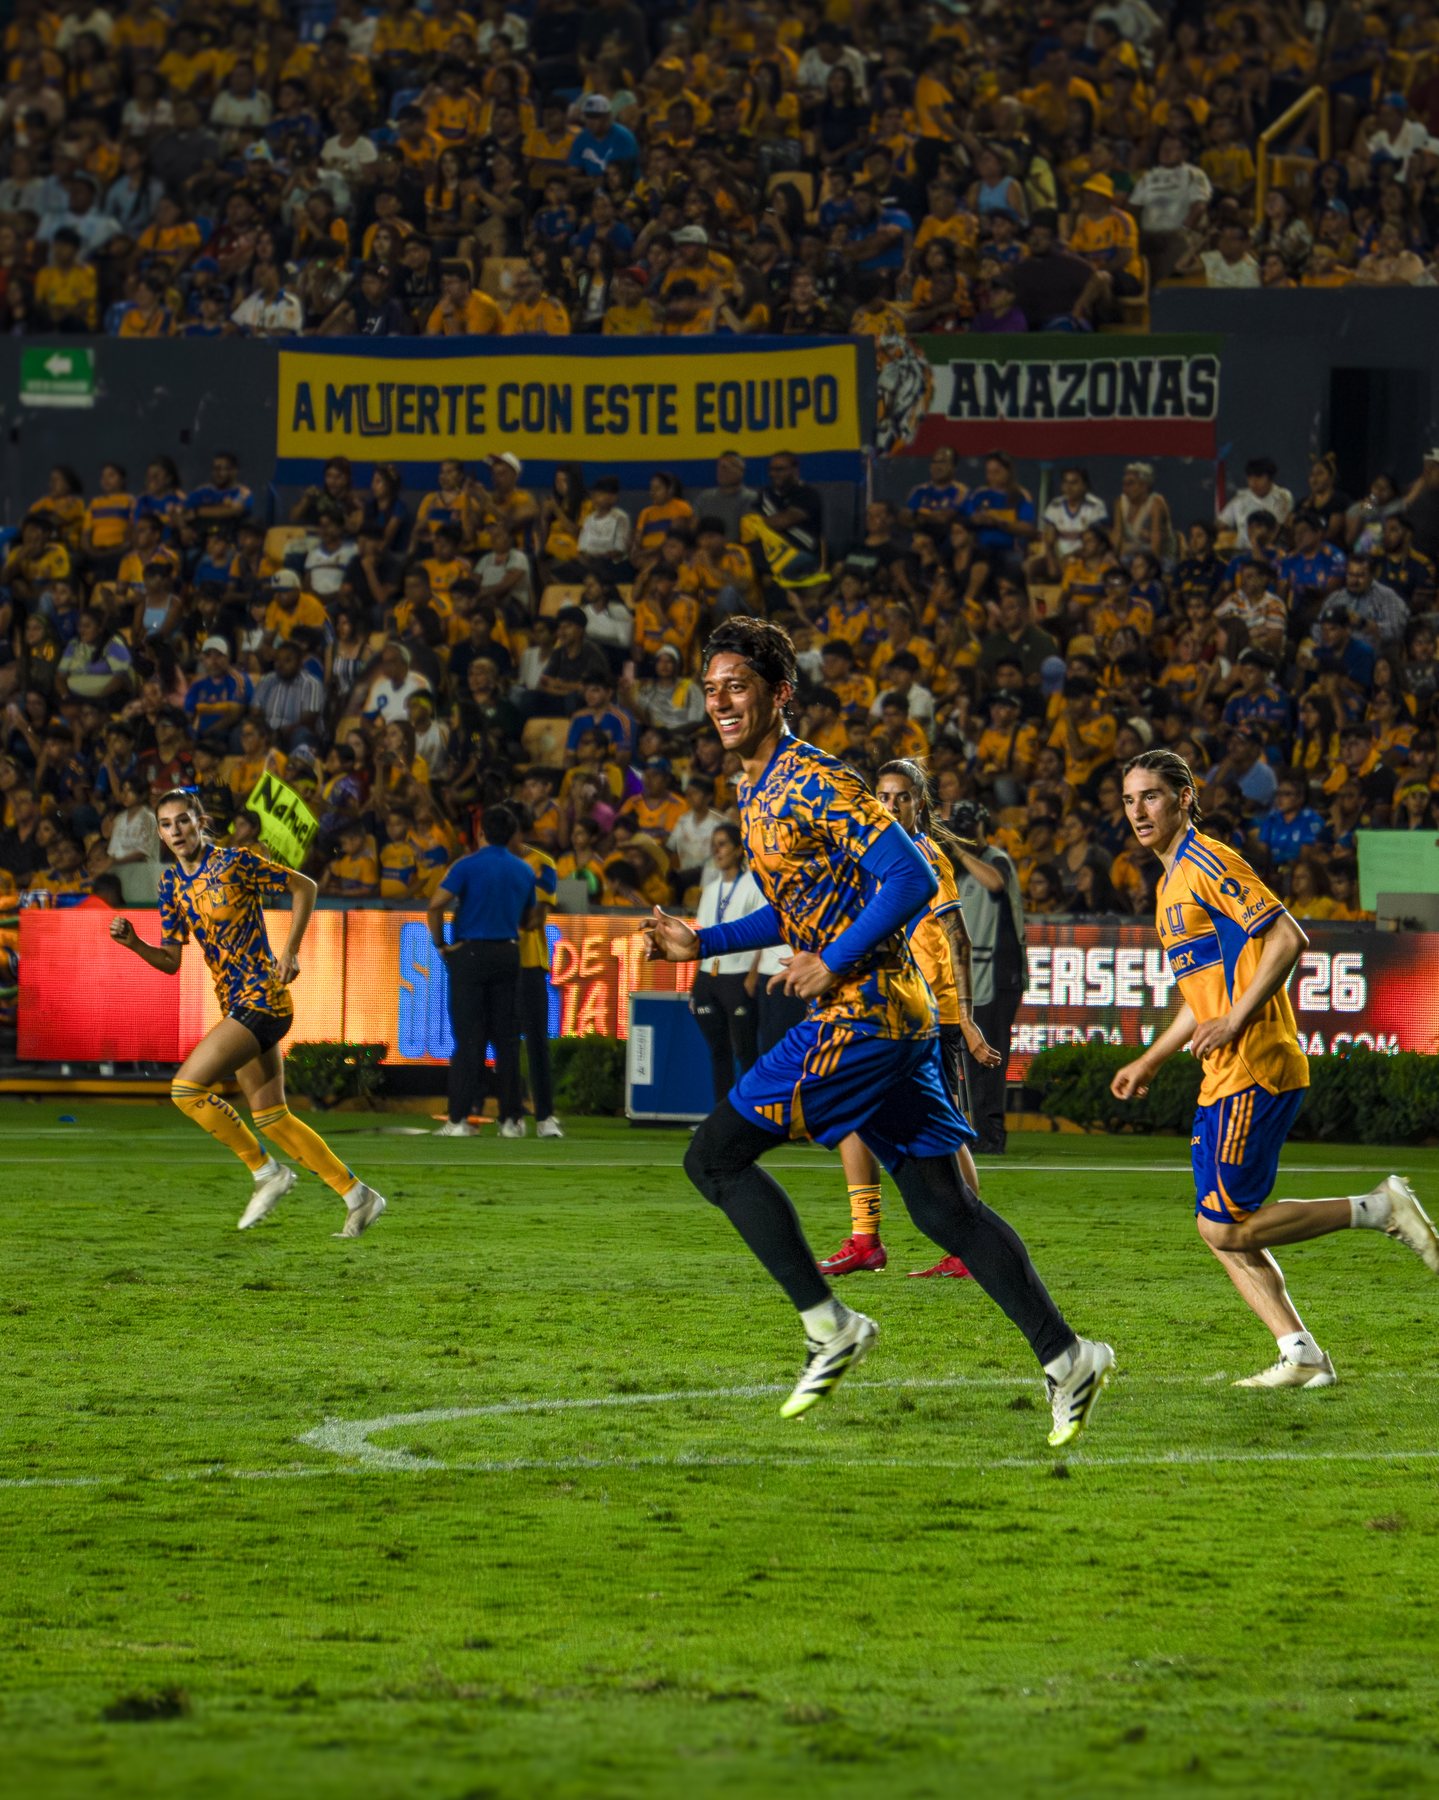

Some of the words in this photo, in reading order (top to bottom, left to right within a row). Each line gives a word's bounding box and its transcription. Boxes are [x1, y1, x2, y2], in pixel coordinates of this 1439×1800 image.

[292, 381, 317, 432] A
[325, 382, 487, 438] MUERTE
[496, 382, 573, 434] CON
[584, 383, 678, 435] ESTE
[694, 373, 839, 435] EQUIPO
[947, 354, 1221, 422] AMAZONAS
[1241, 896, 1267, 924] elcel
[551, 935, 607, 984] DE
[1022, 946, 1178, 1007] ERSEY
[1286, 952, 1368, 1012] 26
